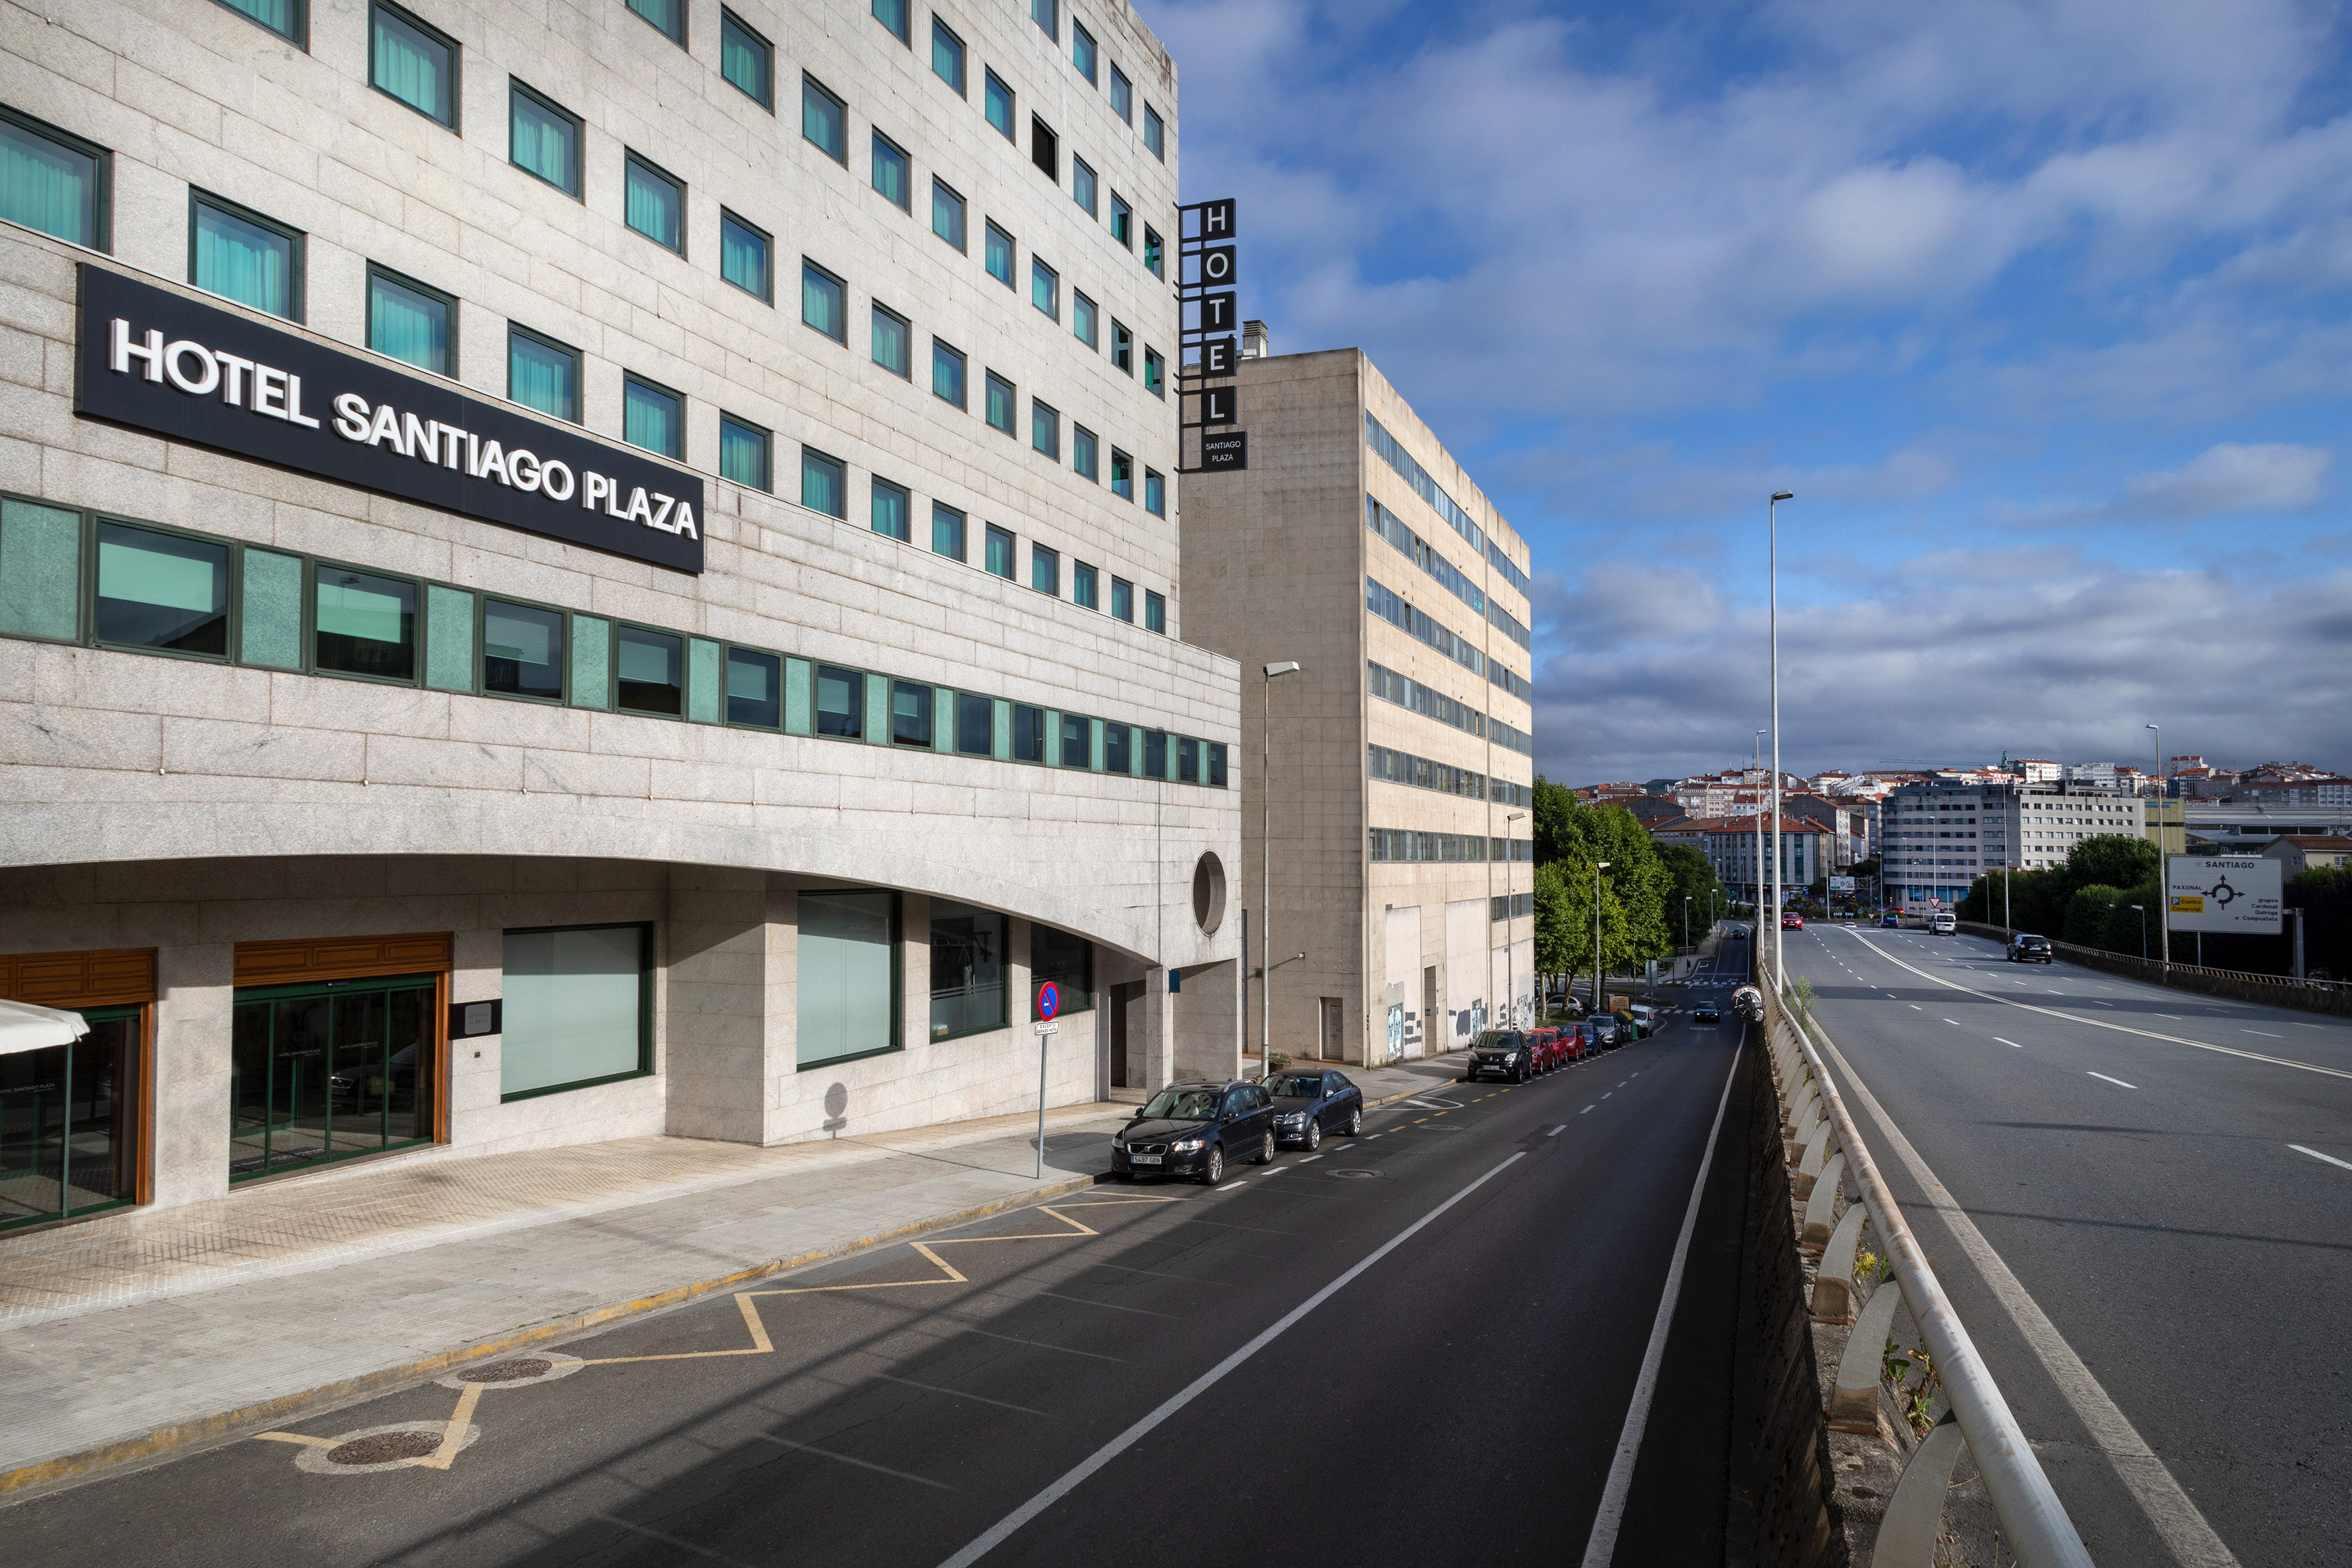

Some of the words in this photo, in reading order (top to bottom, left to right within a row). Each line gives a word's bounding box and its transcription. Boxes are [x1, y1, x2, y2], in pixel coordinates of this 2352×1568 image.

[1207, 205, 1228, 418] HOTEL
[108, 318, 319, 429] HOTEL
[333, 392, 574, 501] SANTIAGO
[583, 470, 698, 540] PLAZA
[1206, 441, 1241, 450] SANTIAGO
